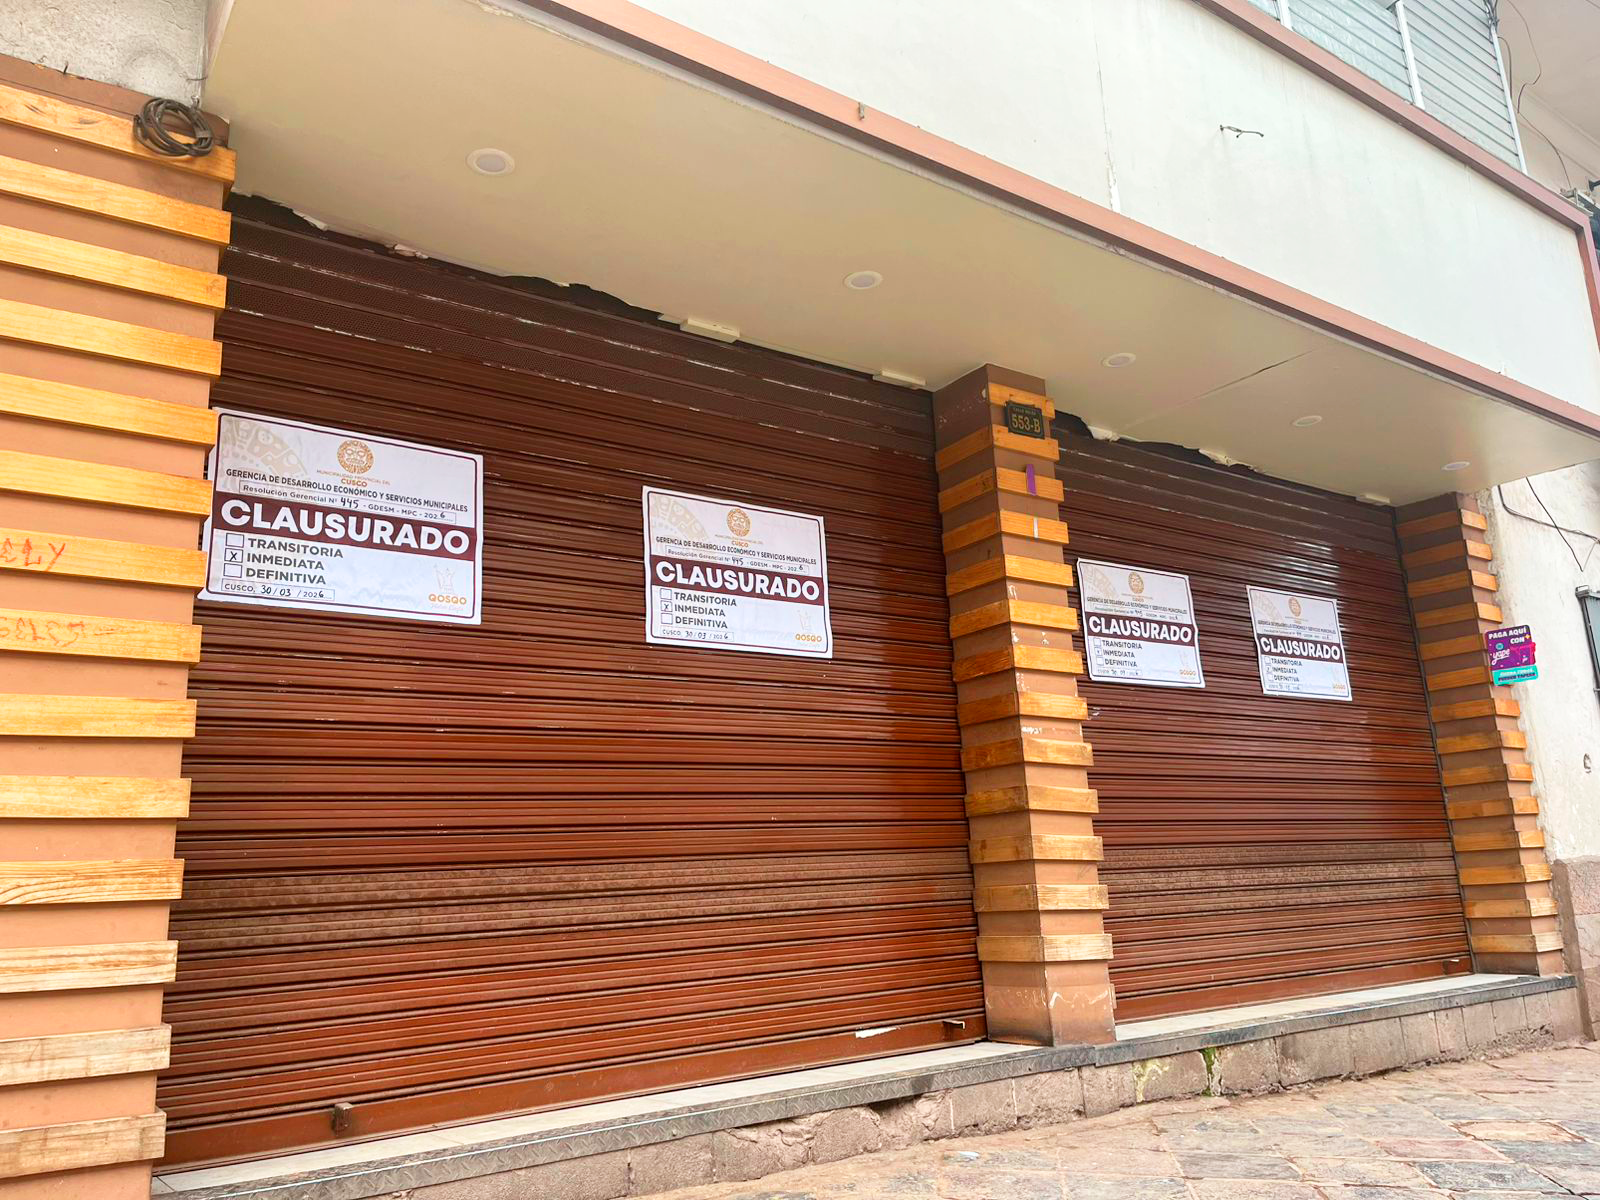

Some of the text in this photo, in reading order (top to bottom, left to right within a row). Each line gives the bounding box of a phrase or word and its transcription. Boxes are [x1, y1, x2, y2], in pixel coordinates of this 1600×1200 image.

[1011, 413, 1041, 433] 553-B
[340, 478, 368, 488] CUSCO
[226, 468, 267, 482] GERENCIA
[269, 475, 280, 484] DE
[281, 477, 332, 492] DESARROLLO
[333, 485, 378, 499] ECONÓMICO
[385, 493, 422, 506] SERVICIOS
[423, 499, 468, 513] MUNICIPALES
[243, 484, 288, 498] Resolución
[289, 491, 327, 503] Gerencial
[367, 503, 395, 513] GDESM
[401, 508, 418, 517] MPC
[220, 499, 470, 554] CLAUSURADO
[247, 537, 344, 559] TRANSITORIA
[655, 536, 683, 546] GERENCIA
[692, 541, 727, 552] DESARROLLO
[760, 551, 786, 561] SERVICIOS
[786, 555, 817, 565] MUNICIPALES
[731, 540, 749, 548] CUSCO
[246, 552, 325, 571] INMEDIATA
[245, 567, 326, 585] DEFINITIVA
[655, 561, 820, 600] CLAUSURADO
[428, 593, 467, 605] QOSQO
[674, 591, 737, 607] TRANSITORIA
[674, 604, 726, 617] INMEDIATA
[675, 616, 728, 629] DEFINITIVA
[1088, 615, 1192, 643] CLAUSURADO
[795, 633, 822, 643] QOSQO
[1488, 631, 1508, 640] PAGA
[1102, 640, 1143, 649] TRANSITORIA
[1260, 637, 1341, 660] CLAUSURADO
[1102, 649, 1135, 658] INMEDIATA
[1104, 659, 1137, 667] DEFINITIVA
[1271, 658, 1303, 667] TRANSITORIA
[1272, 666, 1297, 674] INMEDIATA
